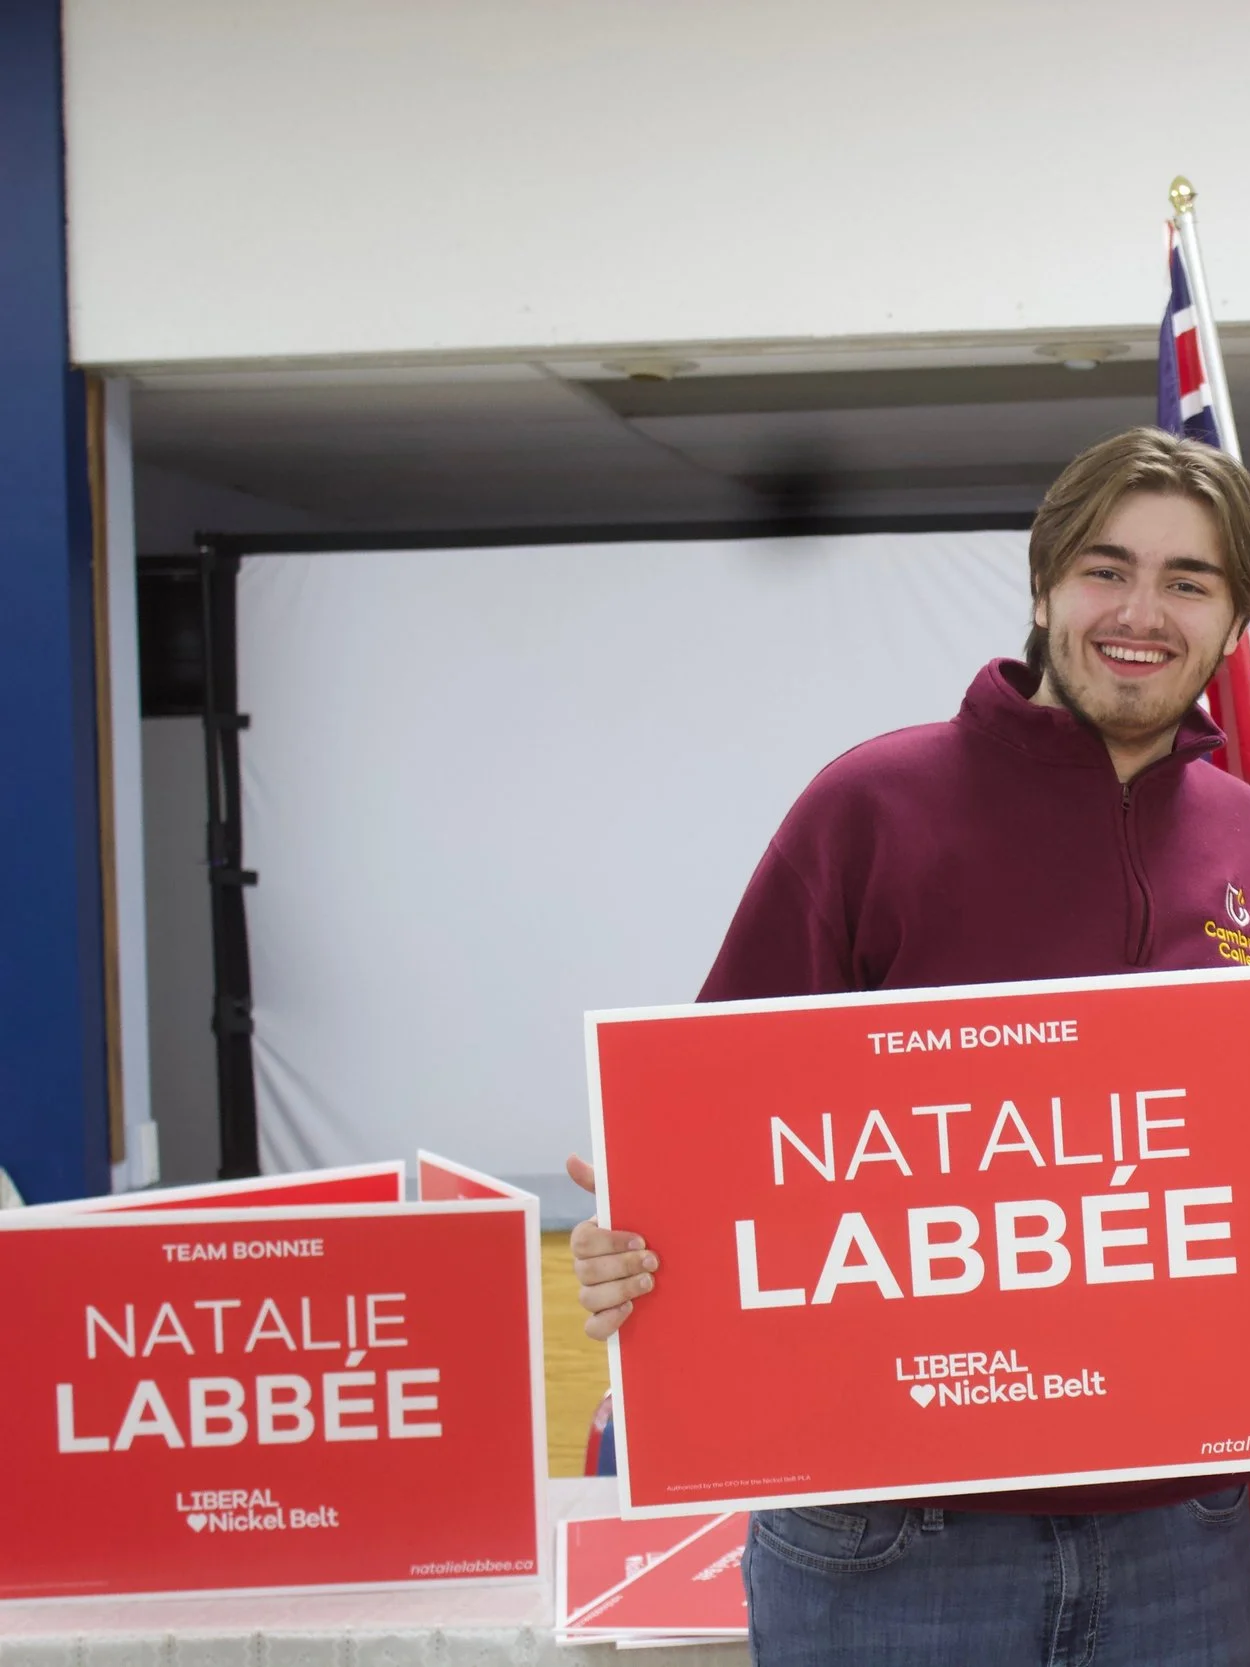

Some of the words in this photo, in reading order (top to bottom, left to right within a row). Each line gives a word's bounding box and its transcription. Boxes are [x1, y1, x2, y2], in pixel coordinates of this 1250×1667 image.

[867, 1030, 952, 1056] TEAM
[959, 1019, 1079, 1049] BONNIE
[769, 1088, 1191, 1186] NATALIE
[162, 1242, 227, 1263] TEAM
[232, 1238, 325, 1261] BONNIE
[734, 1165, 1239, 1311] LABBÉE
[85, 1292, 409, 1360] NATALIE
[895, 1349, 1029, 1382] LIBERAL
[56, 1351, 443, 1454] LABBÉE
[938, 1373, 1038, 1408] Nickel
[1043, 1368, 1107, 1399] Belt
[176, 1488, 280, 1513] LIBERAL
[208, 1508, 287, 1534] Nickel
[289, 1505, 339, 1530] Belt
[409, 1558, 535, 1578] natalielabbee.ca
